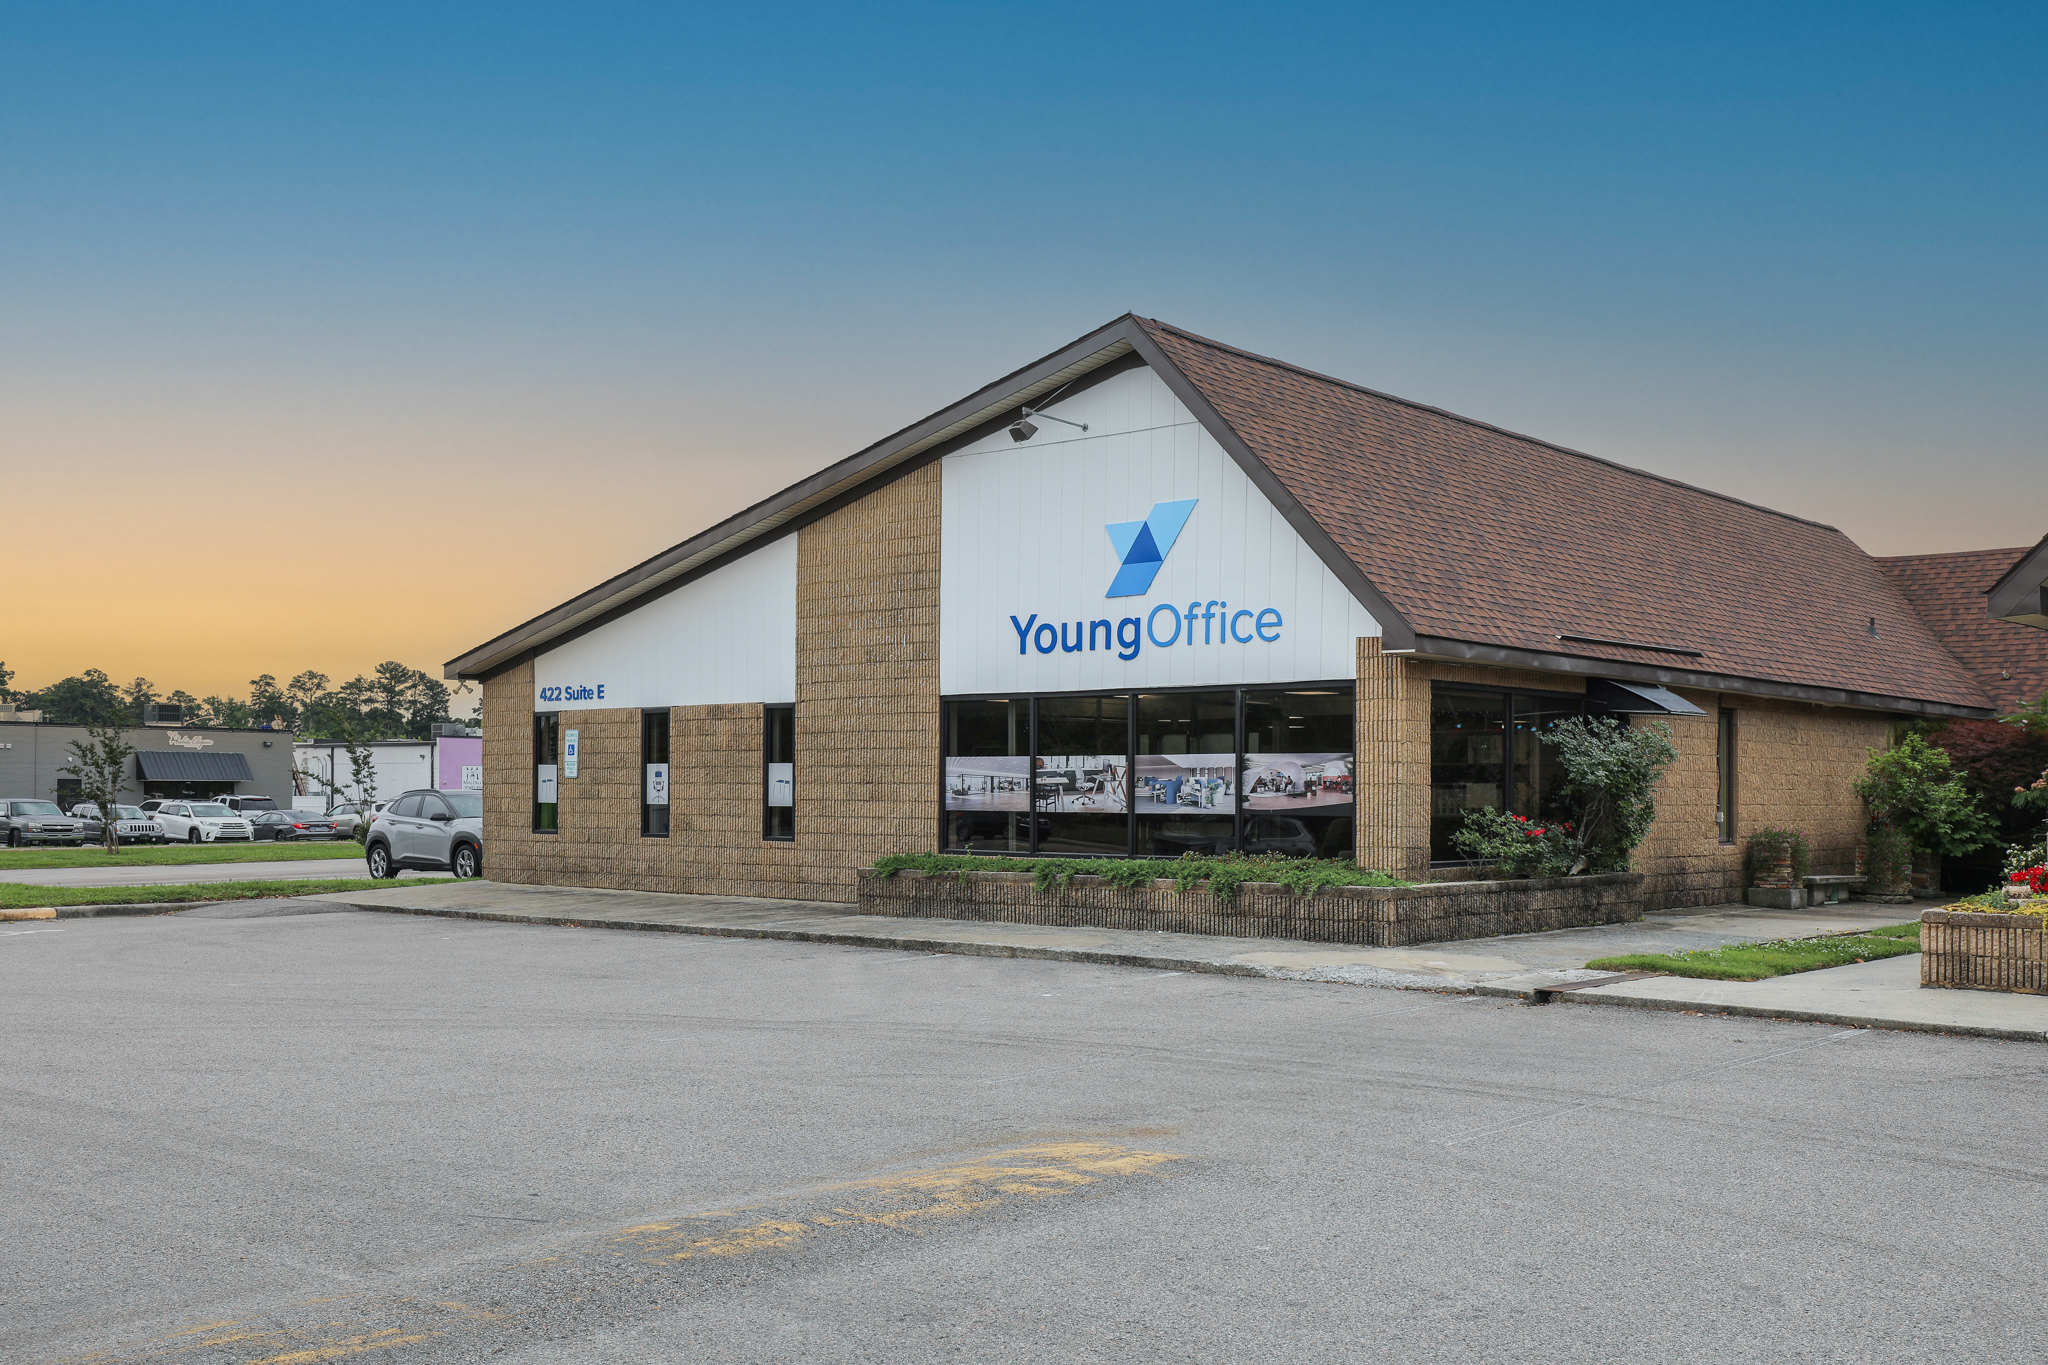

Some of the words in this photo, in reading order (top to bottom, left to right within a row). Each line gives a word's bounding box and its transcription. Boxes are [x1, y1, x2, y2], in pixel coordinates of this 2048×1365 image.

[1009, 600, 1283, 661] YoungOffice
[539, 686, 562, 702] 422
[564, 684, 595, 701] Suite
[597, 683, 605, 700] E
